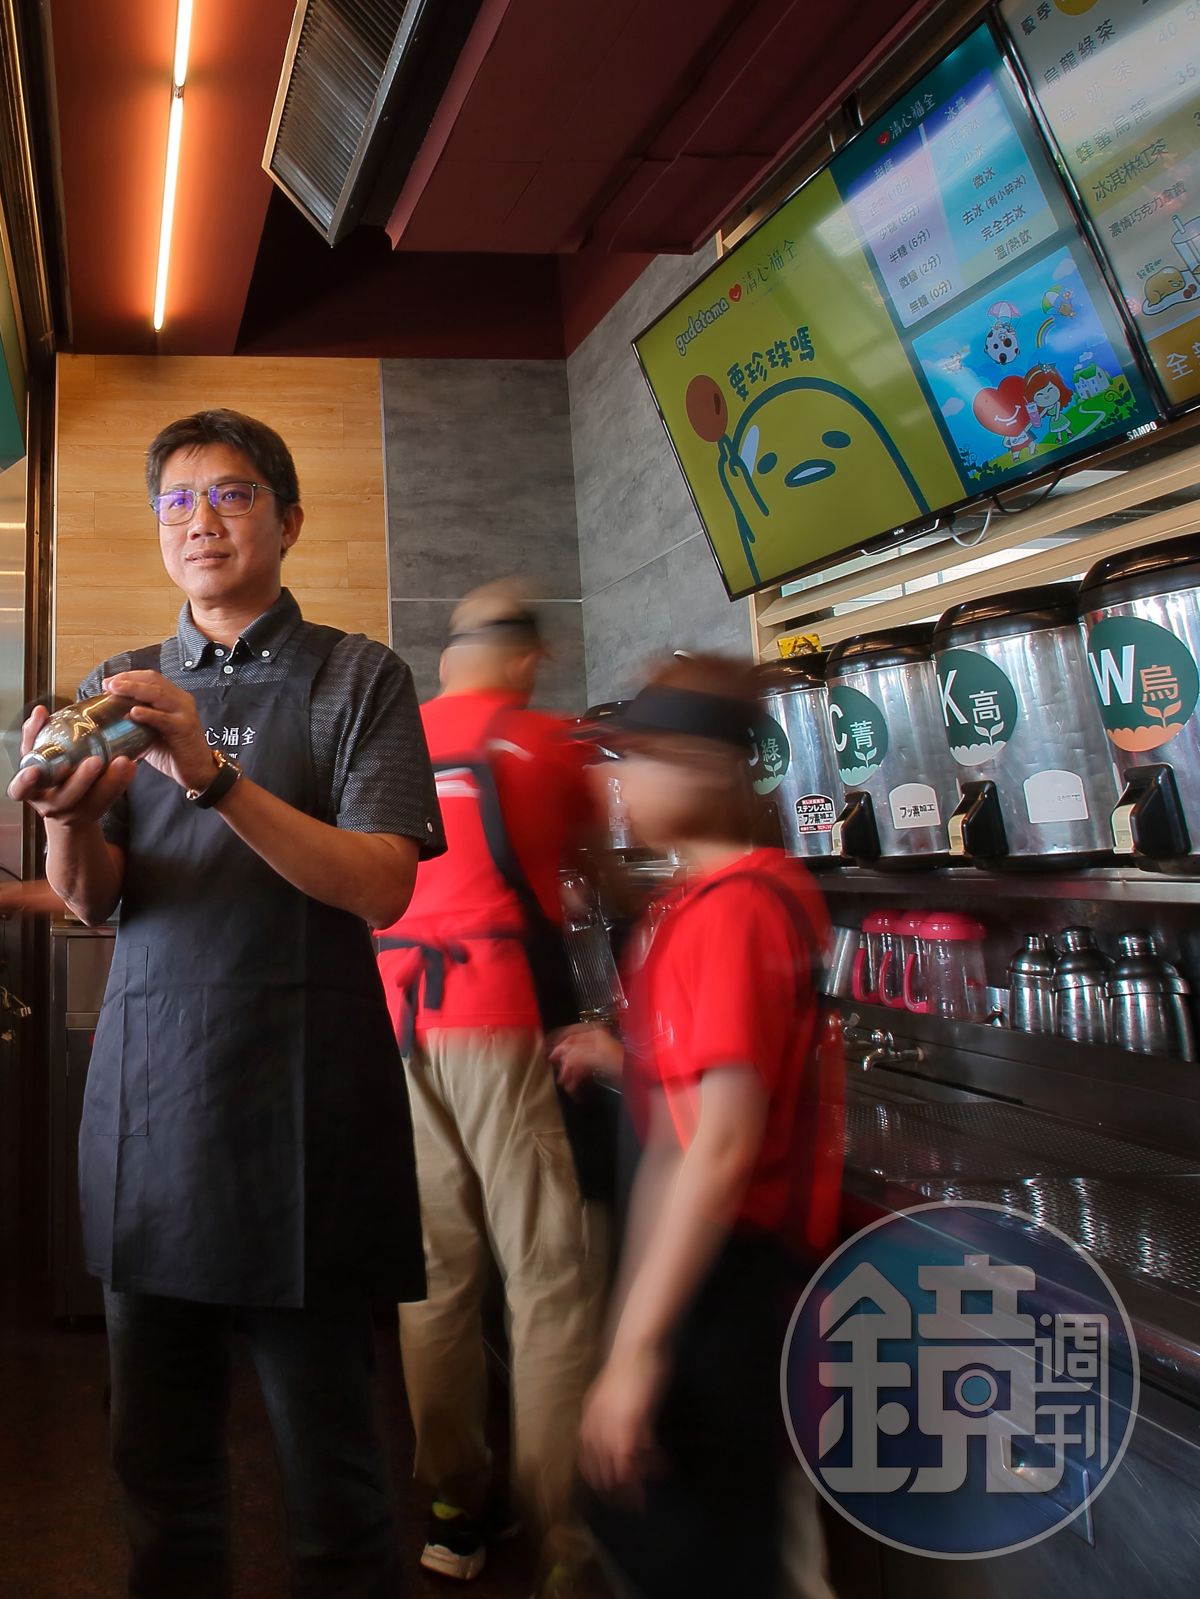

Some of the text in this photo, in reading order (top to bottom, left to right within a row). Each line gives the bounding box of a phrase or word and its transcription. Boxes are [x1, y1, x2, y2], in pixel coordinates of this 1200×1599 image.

[1043, 18, 1116, 88] 烏龍綠茶
[889, 93, 937, 140] 清心福全
[1075, 97, 1152, 164] 蜂蜜烏龍
[972, 167, 996, 189] 微冰
[1091, 138, 1169, 202] 冰淇淋紅茶
[962, 203, 984, 225] 去冰
[980, 204, 1026, 242] 完全去冰
[742, 239, 796, 296] 清心福全
[994, 228, 1033, 261] 溫/熱飲
[675, 297, 730, 357] gudetama
[727, 326, 816, 402] 要珍珠嗎
[1126, 421, 1158, 441] SAMPO
[936, 669, 1002, 727] K 高
[1088, 644, 1179, 706] W 烏
[204, 726, 256, 746] 心福全
[760, 738, 781, 762] 綠
[829, 703, 875, 752] C 菁
